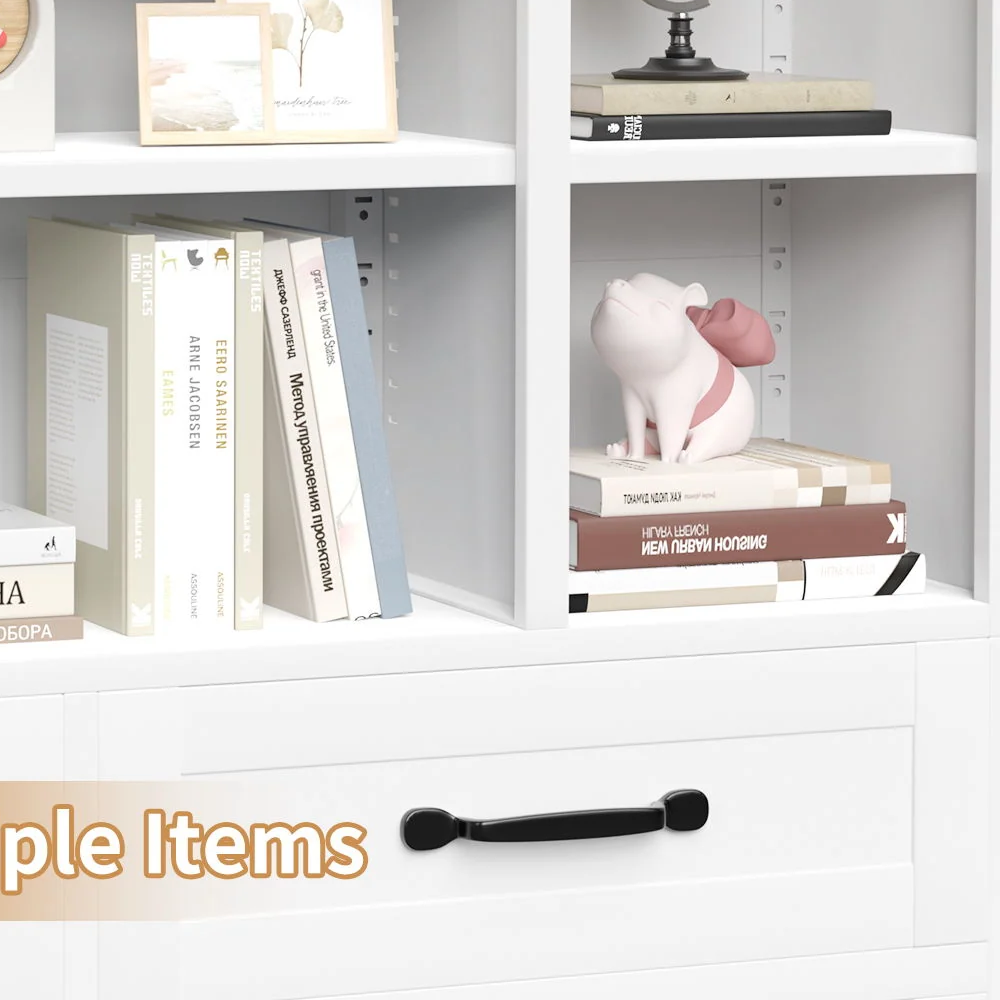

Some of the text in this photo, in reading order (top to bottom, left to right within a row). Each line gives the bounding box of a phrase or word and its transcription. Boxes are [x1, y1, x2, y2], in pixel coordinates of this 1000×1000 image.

[273, 269, 297, 360] ДЖЕФФ САЗЕРЛЕНД
[189, 335, 201, 449] ARNE JACOBSEN
[215, 340, 227, 449] EERO SAARINEN
[289, 372, 306, 420] Метод
[310, 514, 334, 593] проектами
